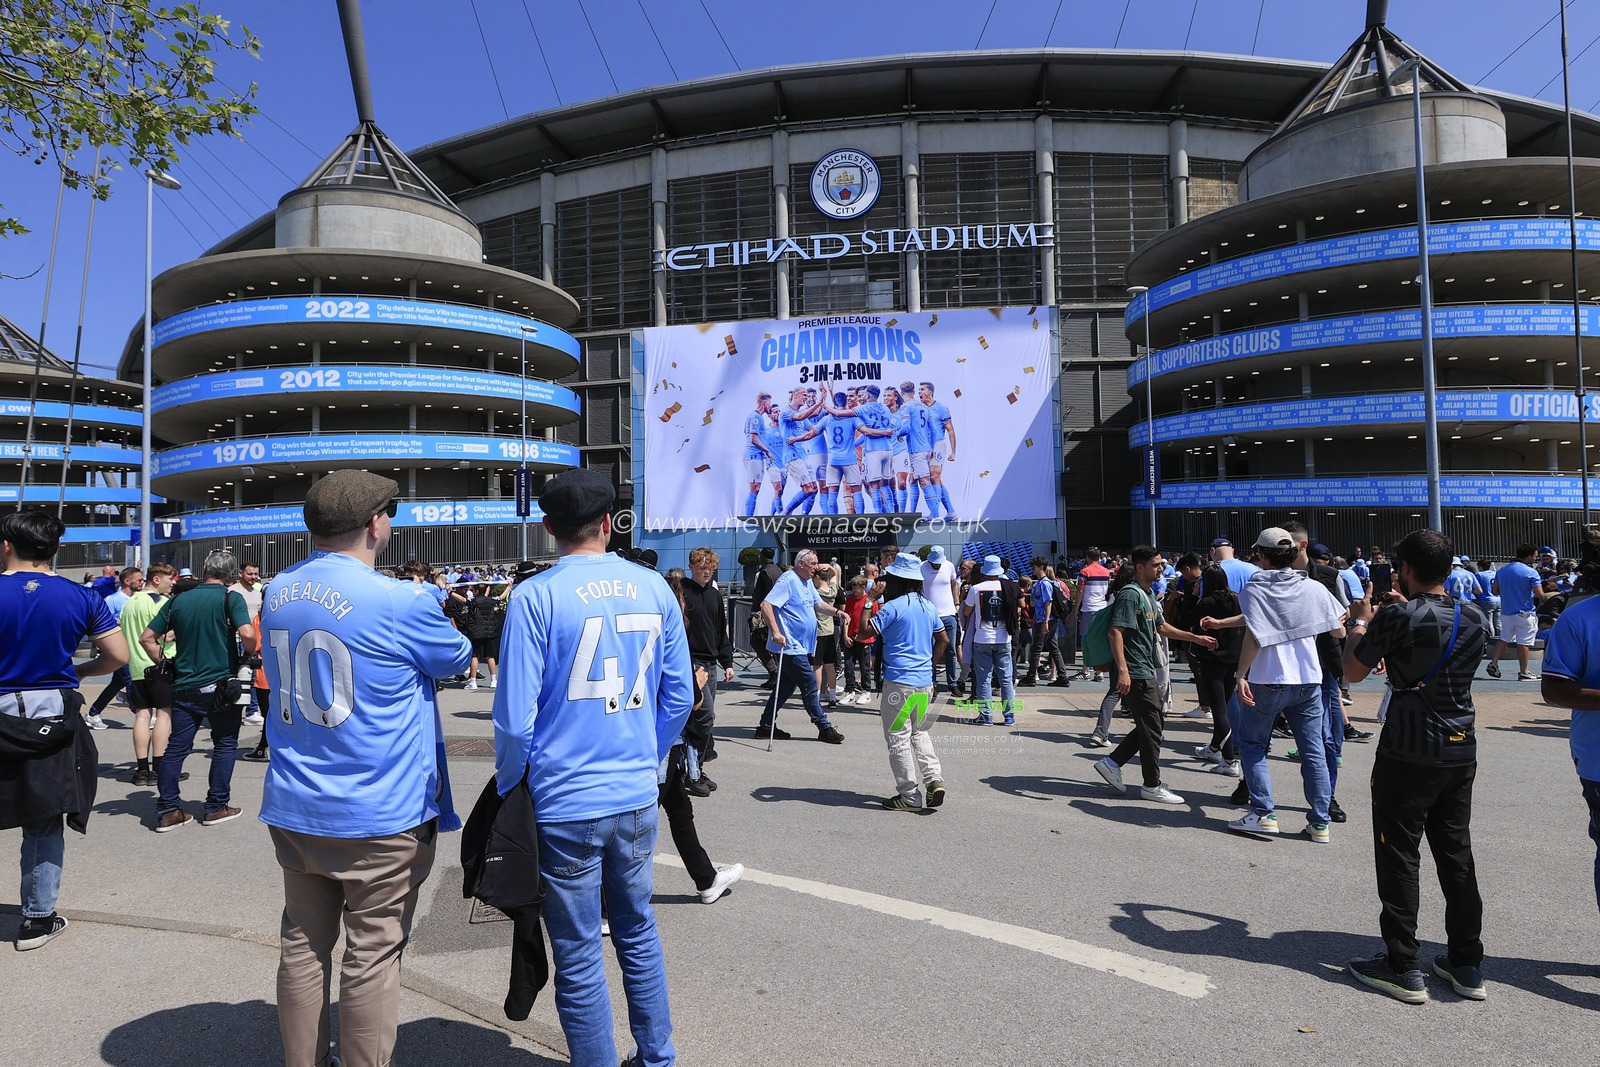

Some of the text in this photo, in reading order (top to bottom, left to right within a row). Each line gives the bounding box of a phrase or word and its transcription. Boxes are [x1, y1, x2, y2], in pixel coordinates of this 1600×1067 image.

[817, 154, 873, 177] MANCHESTER
[667, 223, 1038, 271] ETIHAD STADIUM
[306, 301, 370, 318] 2022
[377, 304, 391, 312] City
[392, 304, 414, 312] defeat
[415, 306, 434, 314] Aston
[418, 314, 448, 323] following
[448, 317, 472, 326] another
[472, 320, 497, 329] dramatic
[799, 316, 881, 329] PREMIER LEAGUE
[760, 326, 922, 372] CHAMPIONS
[1162, 330, 1280, 371] SUPPORTERS CLUBS
[280, 370, 340, 388] 2012
[347, 371, 362, 379] City
[418, 372, 441, 381] League
[800, 363, 882, 383] 3-IN-A-ROW
[380, 379, 402, 387] Sergio
[403, 380, 427, 388] Agüero
[1510, 394, 1589, 418] OFFICIA
[351, 440, 384, 448] European
[385, 440, 410, 448] trophy,
[832, 426, 844, 445] 8
[38, 448, 59, 457] HERE
[213, 442, 265, 463] 1970
[499, 442, 539, 459] 1986
[238, 514, 273, 522] Wanderers
[411, 504, 468, 522] 1923
[474, 505, 485, 513] City
[268, 581, 354, 621] GREALISH
[575, 579, 638, 605] FODEN
[567, 613, 663, 715] 47
[269, 628, 354, 729] 10
